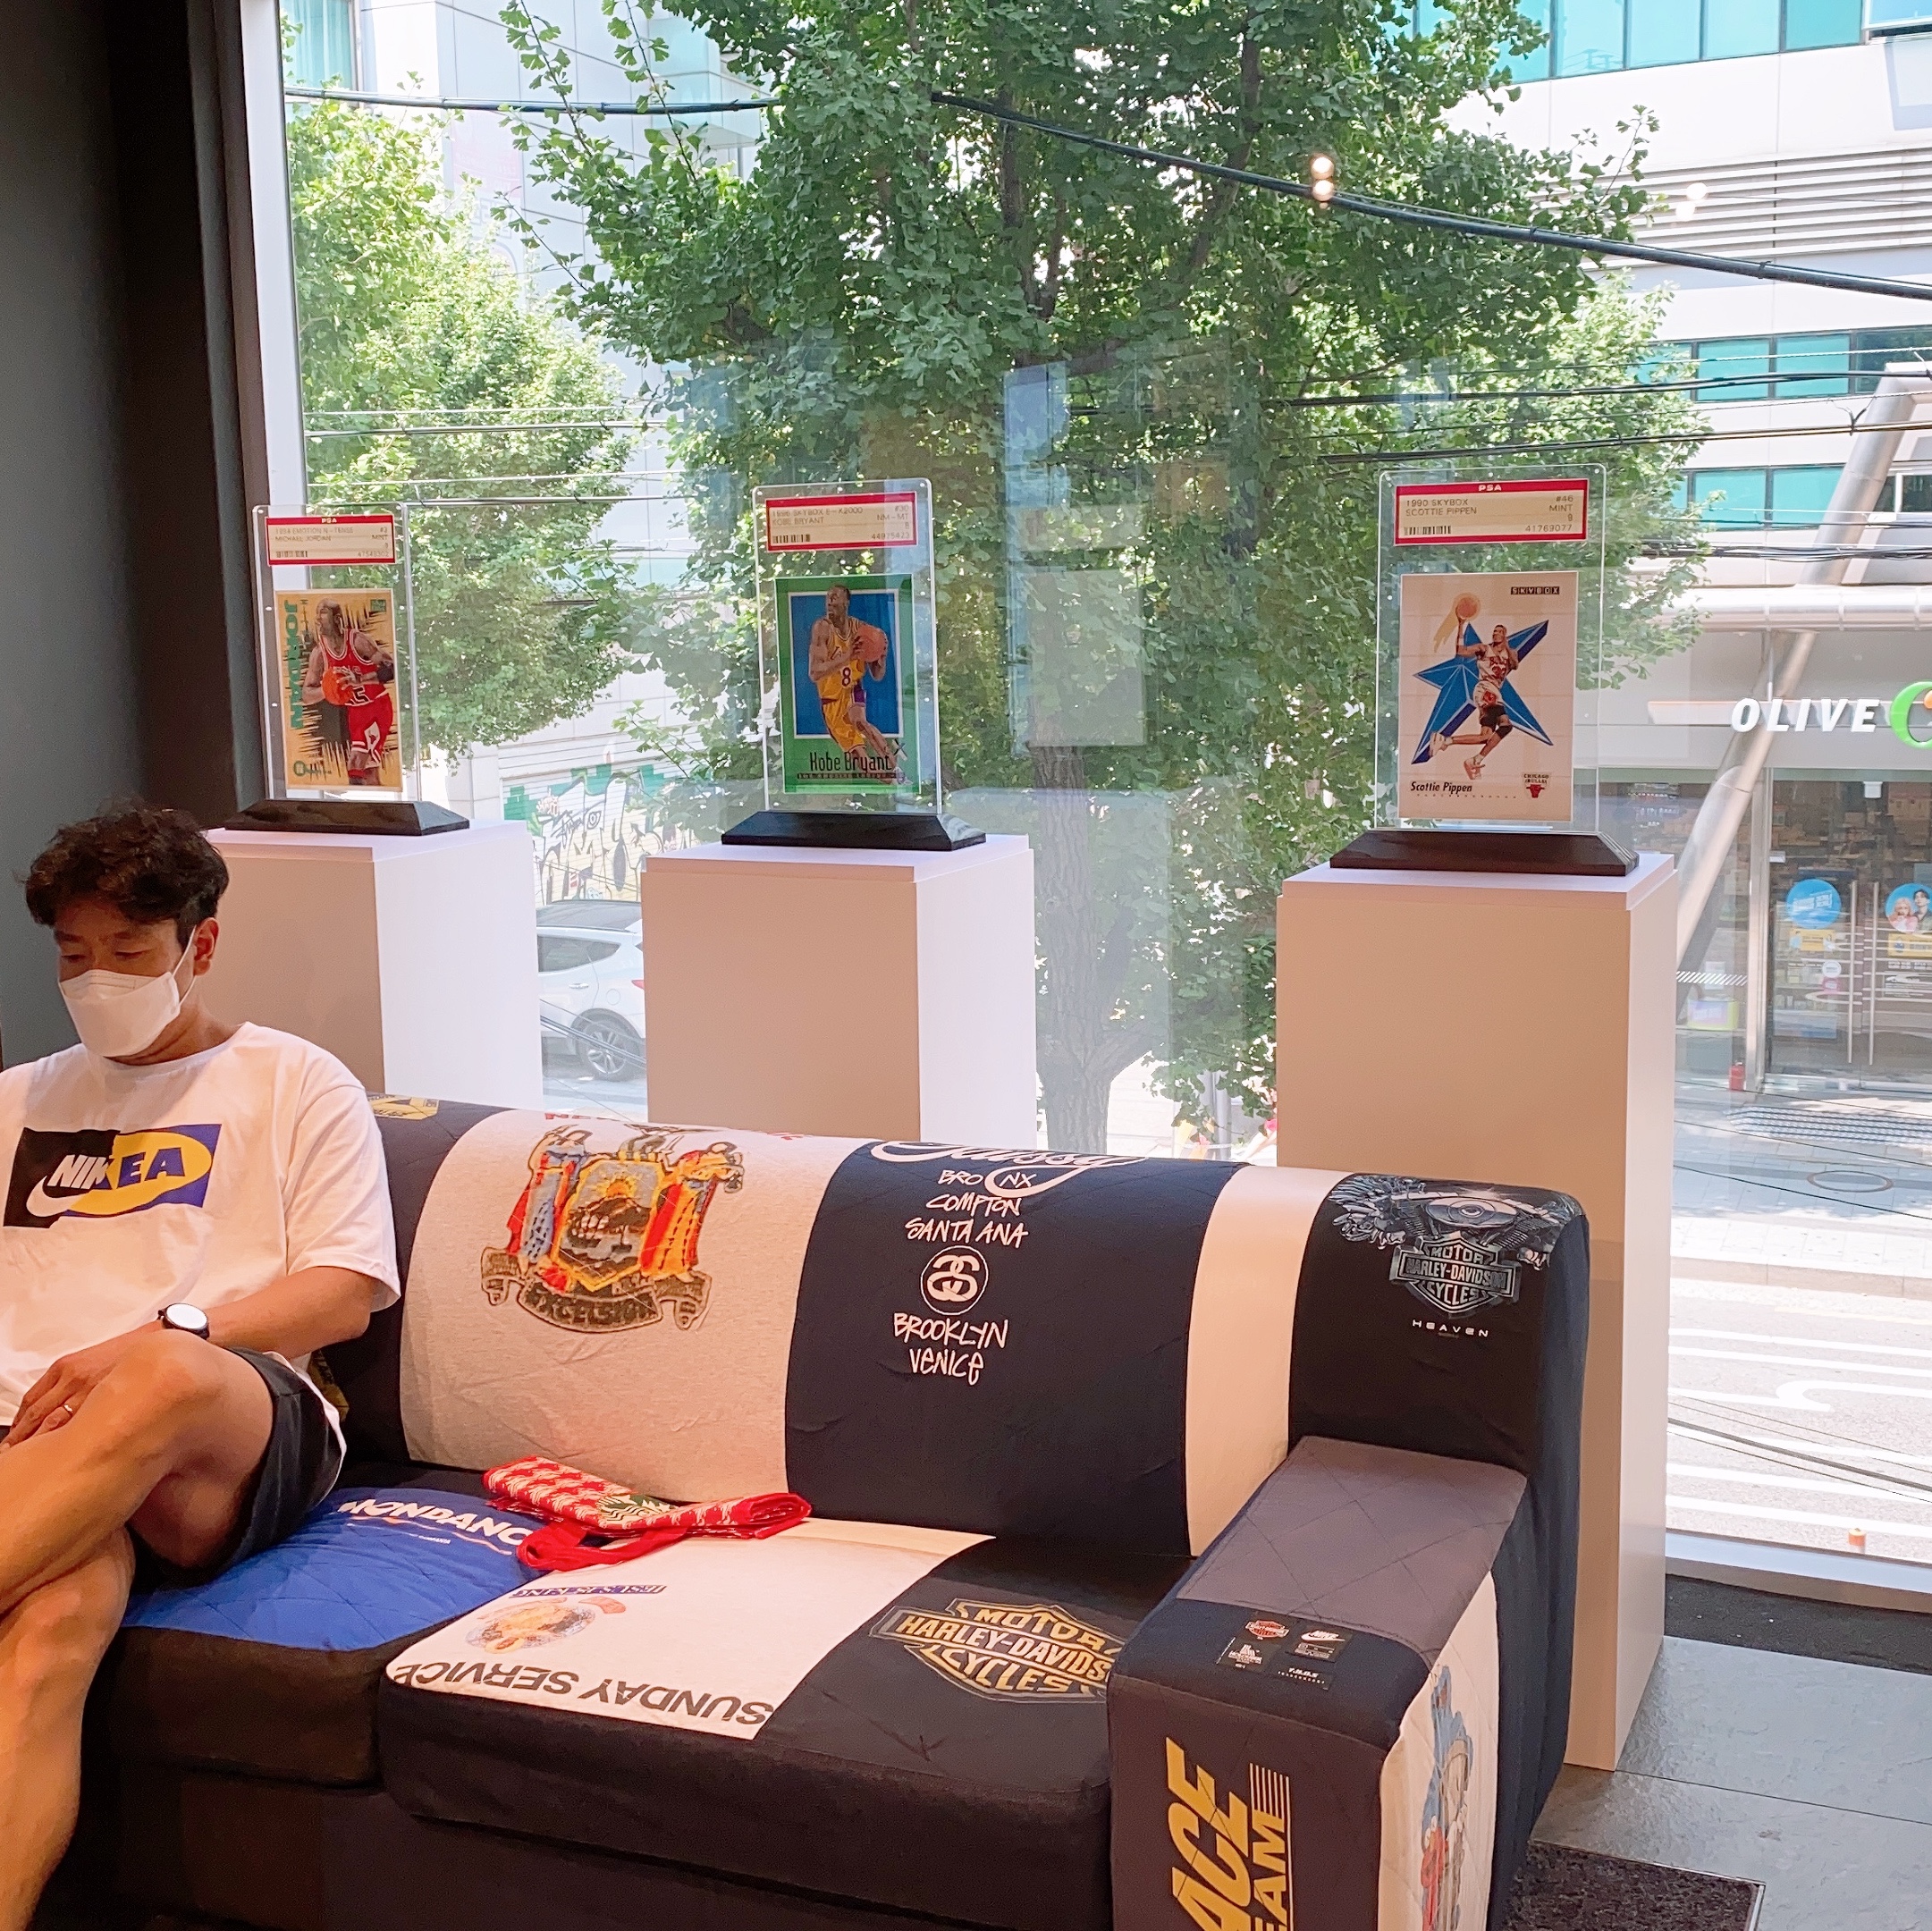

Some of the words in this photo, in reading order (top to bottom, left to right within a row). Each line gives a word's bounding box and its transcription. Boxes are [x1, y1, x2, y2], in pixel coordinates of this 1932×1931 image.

[1405, 508, 1444, 517] SCOTTIE
[1447, 507, 1478, 516] PIPPEN
[1406, 499, 1429, 507] 1990
[1431, 498, 1469, 507] SKYBOX
[1548, 504, 1573, 512] MINT
[772, 518, 791, 526] KOBE
[795, 517, 824, 525] BRYANT
[1511, 586, 1559, 594] SKYBOX
[284, 599, 305, 729] JORDAN
[842, 667, 851, 687] 8
[1730, 696, 1882, 734] OLIVE
[810, 751, 840, 772] Kobe
[844, 750, 893, 774] Bryant
[1410, 780, 1440, 792] Scottie
[1442, 781, 1472, 794] Pippen
[925, 1191, 1022, 1218] COMPTON
[905, 1217, 974, 1244] SANTA
[975, 1219, 1029, 1249] ANA
[1431, 1244, 1488, 1264] MOTOR
[1404, 1258, 1508, 1290] HARLEY-DAVIDSON
[1429, 1281, 1481, 1305] CYCLES
[894, 1312, 1008, 1350] BROOKLYN
[1412, 1319, 1489, 1337] HEAVEN
[973, 1608, 1106, 1654] MOTOR
[895, 1615, 1114, 1682] HARLEY-DAVIDS
[393, 1661, 579, 1696] SERVICE
[941, 1648, 1074, 1692] CYCLES
[578, 1678, 775, 1725] SUNDAY
